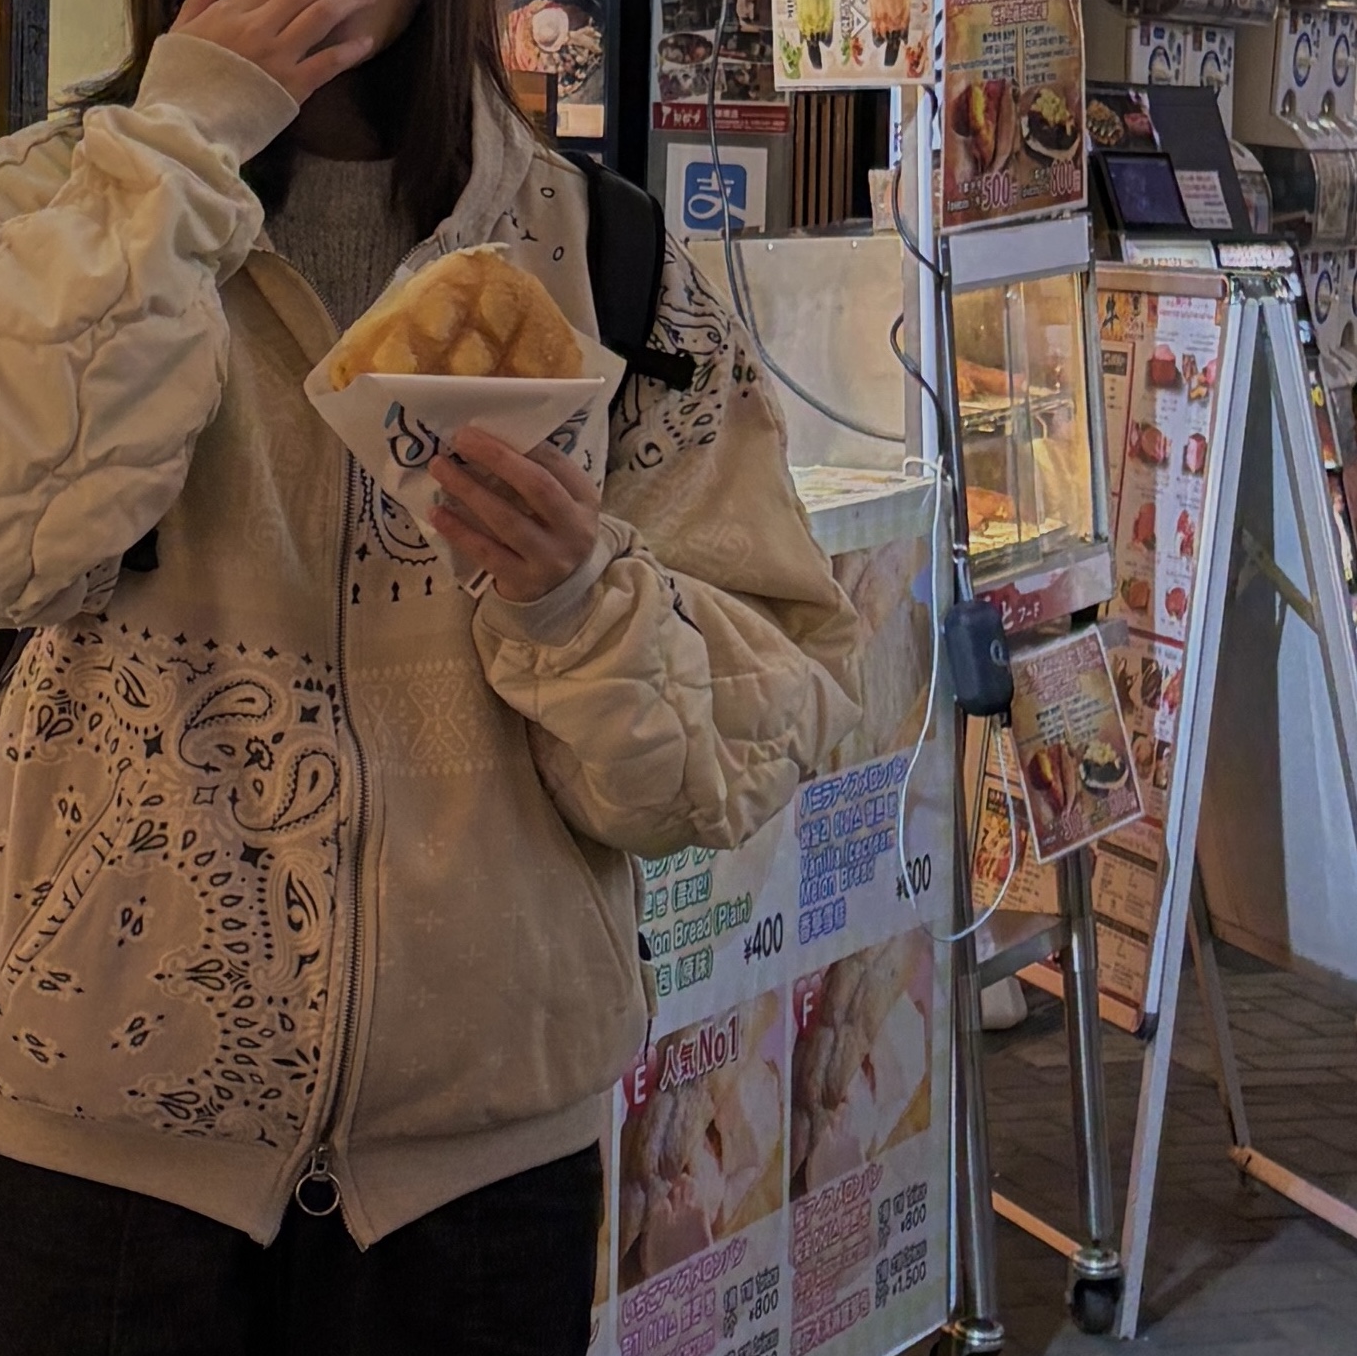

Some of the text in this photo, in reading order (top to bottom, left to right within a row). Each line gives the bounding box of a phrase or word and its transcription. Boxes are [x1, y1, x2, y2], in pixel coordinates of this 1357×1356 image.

[801, 846, 841, 880] Vanilla
[673, 907, 712, 950] Bread
[713, 891, 752, 937] (Plain)
[744, 911, 784, 965] ¥400
[801, 991, 815, 1027] F
[632, 1065, 648, 1105] E
[891, 1261, 927, 1297] ¥1,500
[748, 1288, 779, 1322] ¥800
